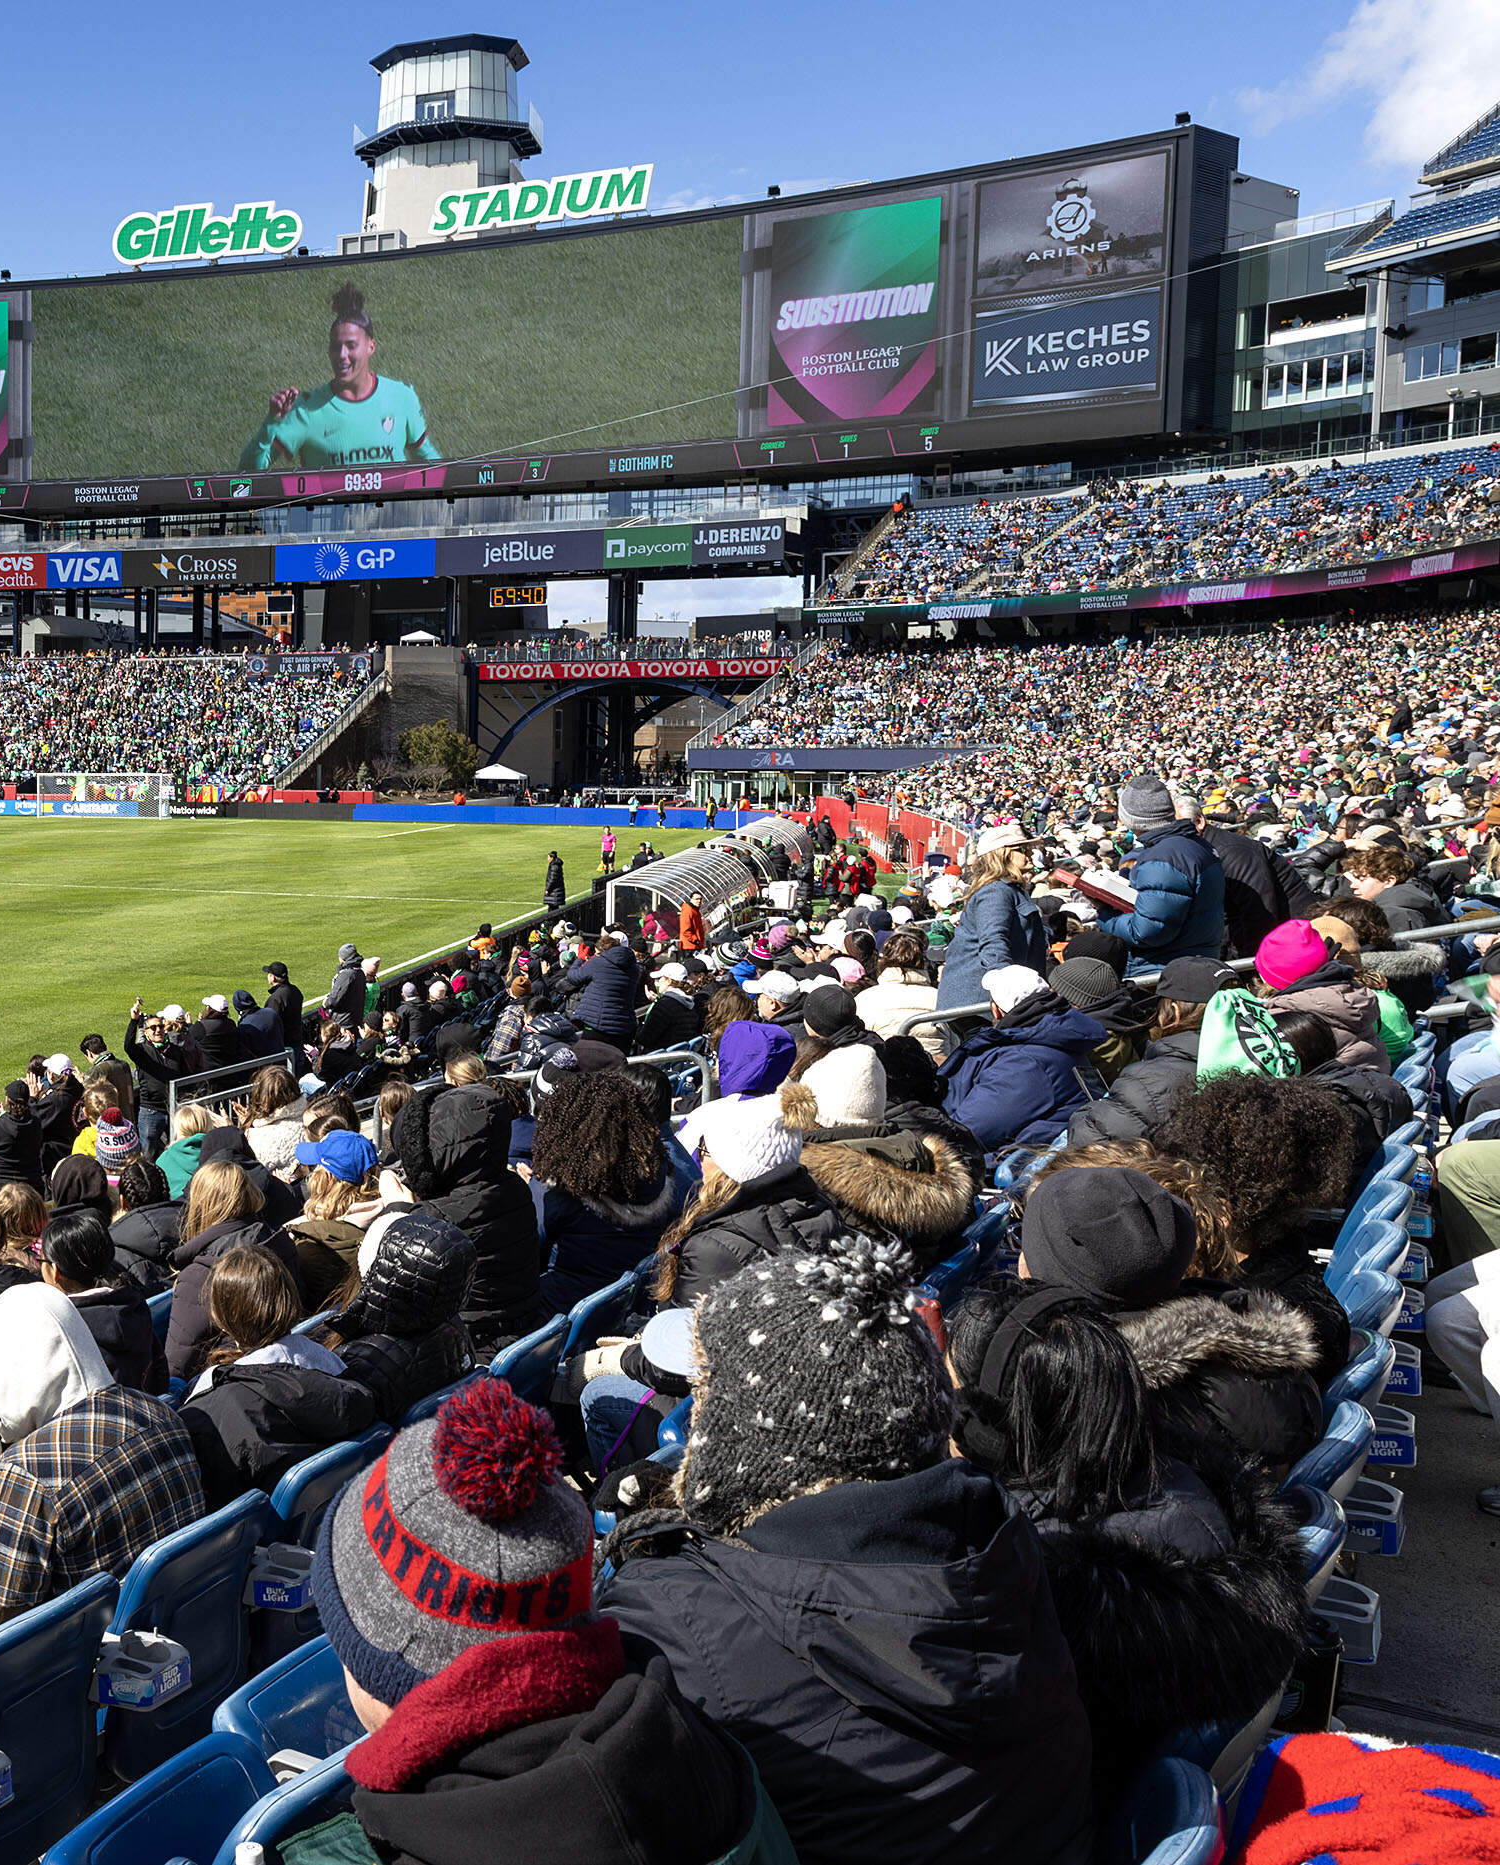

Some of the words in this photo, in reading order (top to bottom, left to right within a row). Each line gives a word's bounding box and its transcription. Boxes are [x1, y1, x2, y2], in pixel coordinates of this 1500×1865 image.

[433, 168, 649, 231] STADIUM
[115, 205, 299, 261] Gillette
[1026, 241, 1111, 263] ARIENS
[776, 282, 935, 331] SUBSTITUTION
[1027, 319, 1150, 355] KECHES
[802, 351, 852, 366] BOSTON
[856, 346, 903, 360] LEGACY
[1027, 357, 1070, 374] LAW
[1077, 348, 1150, 369] GROUP
[802, 361, 865, 377] FOOTBALL
[868, 357, 900, 370] CLUB
[839, 434, 858, 443] SAVES
[924, 436, 933, 451] 5
[768, 450, 774, 465] 1
[843, 443, 849, 458] 1
[618, 456, 659, 472] GOTHAM
[661, 455, 674, 469] FC
[344, 472, 382, 491] 69:39
[420, 470, 426, 487] 1
[532, 468, 538, 479] 3
[74, 487, 107, 496] BOSTON
[109, 486, 140, 494] LEGACY
[196, 488, 202, 497] 3
[298, 476, 305, 494] 0
[75, 494, 116, 503] FOOTBALL
[116, 493, 138, 502] CLUB
[694, 524, 782, 546] J.DERENZO
[484, 542, 554, 568] jetBlue
[627, 542, 687, 560] paycom
[708, 545, 767, 557] COMPANIES
[0, 556, 34, 571] CVS
[49, 557, 120, 583] VISA
[177, 554, 237, 573] CROSS
[179, 573, 237, 581] INSURANCE
[493, 587, 545, 605] 69:40
[1105, 594, 1129, 602] LEGACY
[1187, 583, 1246, 603] SUBSTITUTION
[927, 603, 992, 621] SUBSTITUTION
[1080, 602, 1111, 610] FOOTBALL
[297, 663, 310, 672] AIR
[487, 664, 554, 679] TOYOTA
[561, 662, 631, 677] TOYOTA
[638, 661, 710, 676] TOYOTA
[14, 800, 37, 810] prime
[1372, 1440, 1398, 1449] BUD
[365, 1479, 572, 1626] PATRIOTS
[263, 1594, 290, 1602] LIGHT
[266, 1587, 285, 1595] BUD
[163, 1665, 179, 1682] BUD
[160, 1673, 181, 1694] LIGHT
